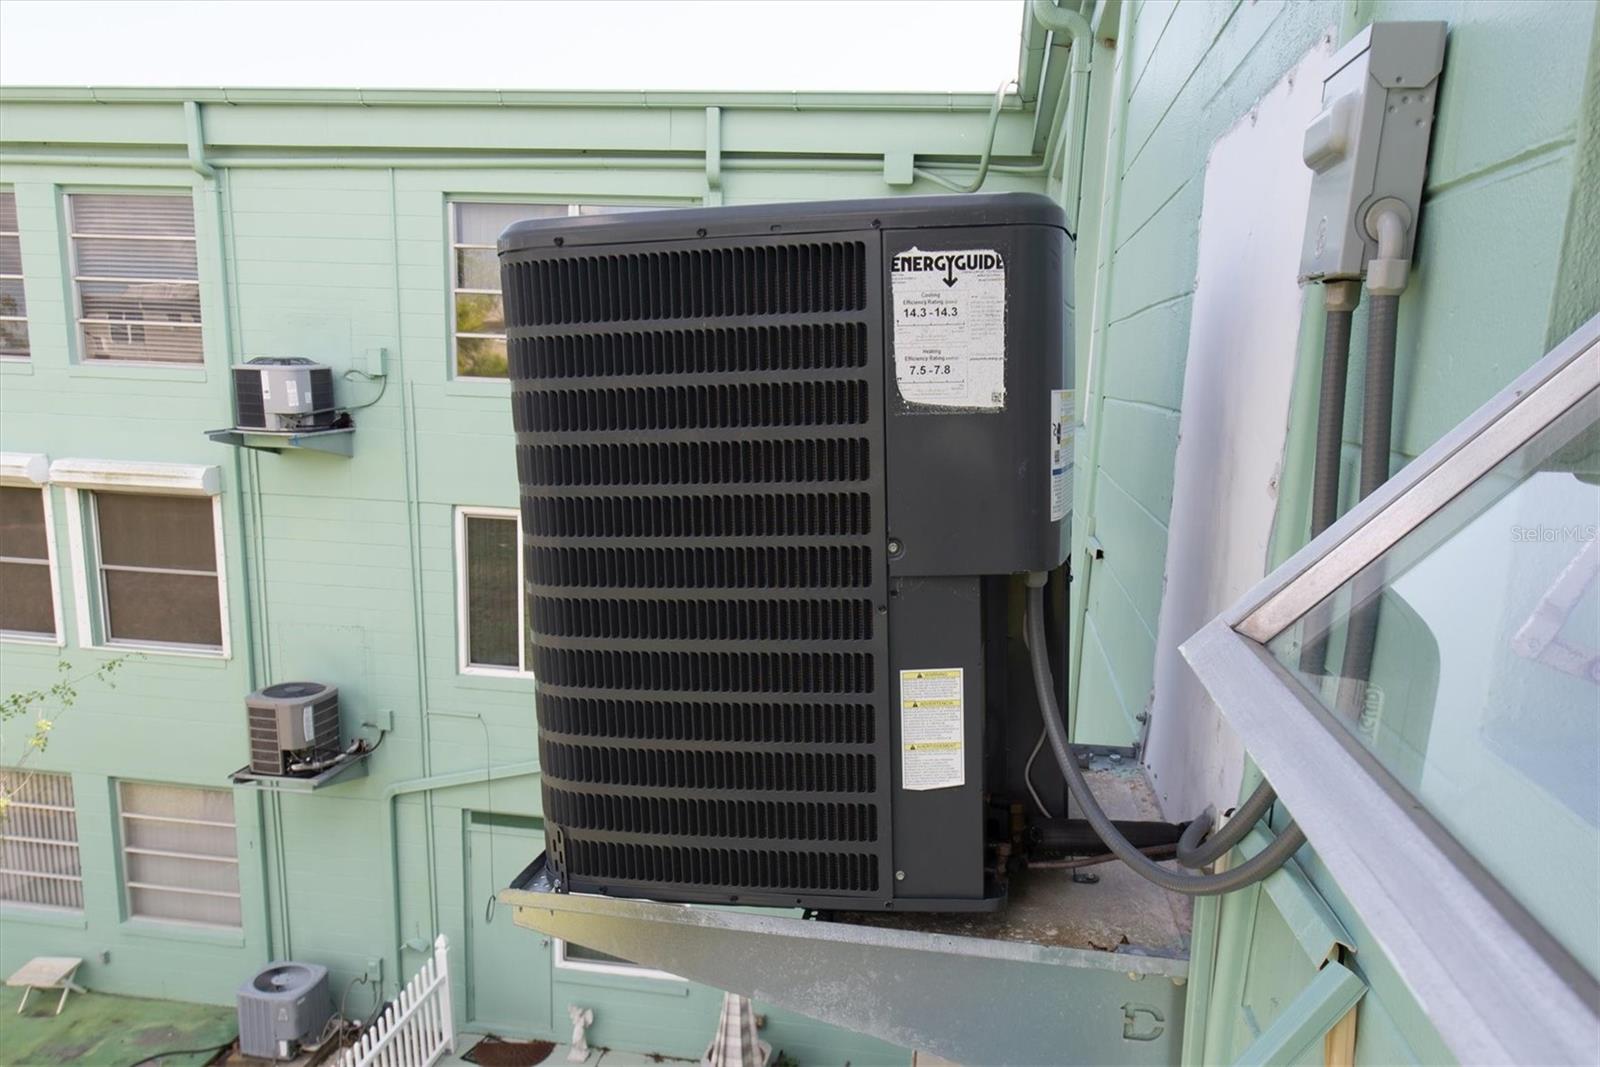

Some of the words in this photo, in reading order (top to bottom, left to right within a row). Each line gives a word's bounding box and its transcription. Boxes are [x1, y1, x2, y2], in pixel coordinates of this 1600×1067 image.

[904, 308, 927, 318] 14.3
[935, 307, 958, 317] 14.3
[910, 365, 927, 375] 7.5
[934, 364, 951, 375] 7.8
